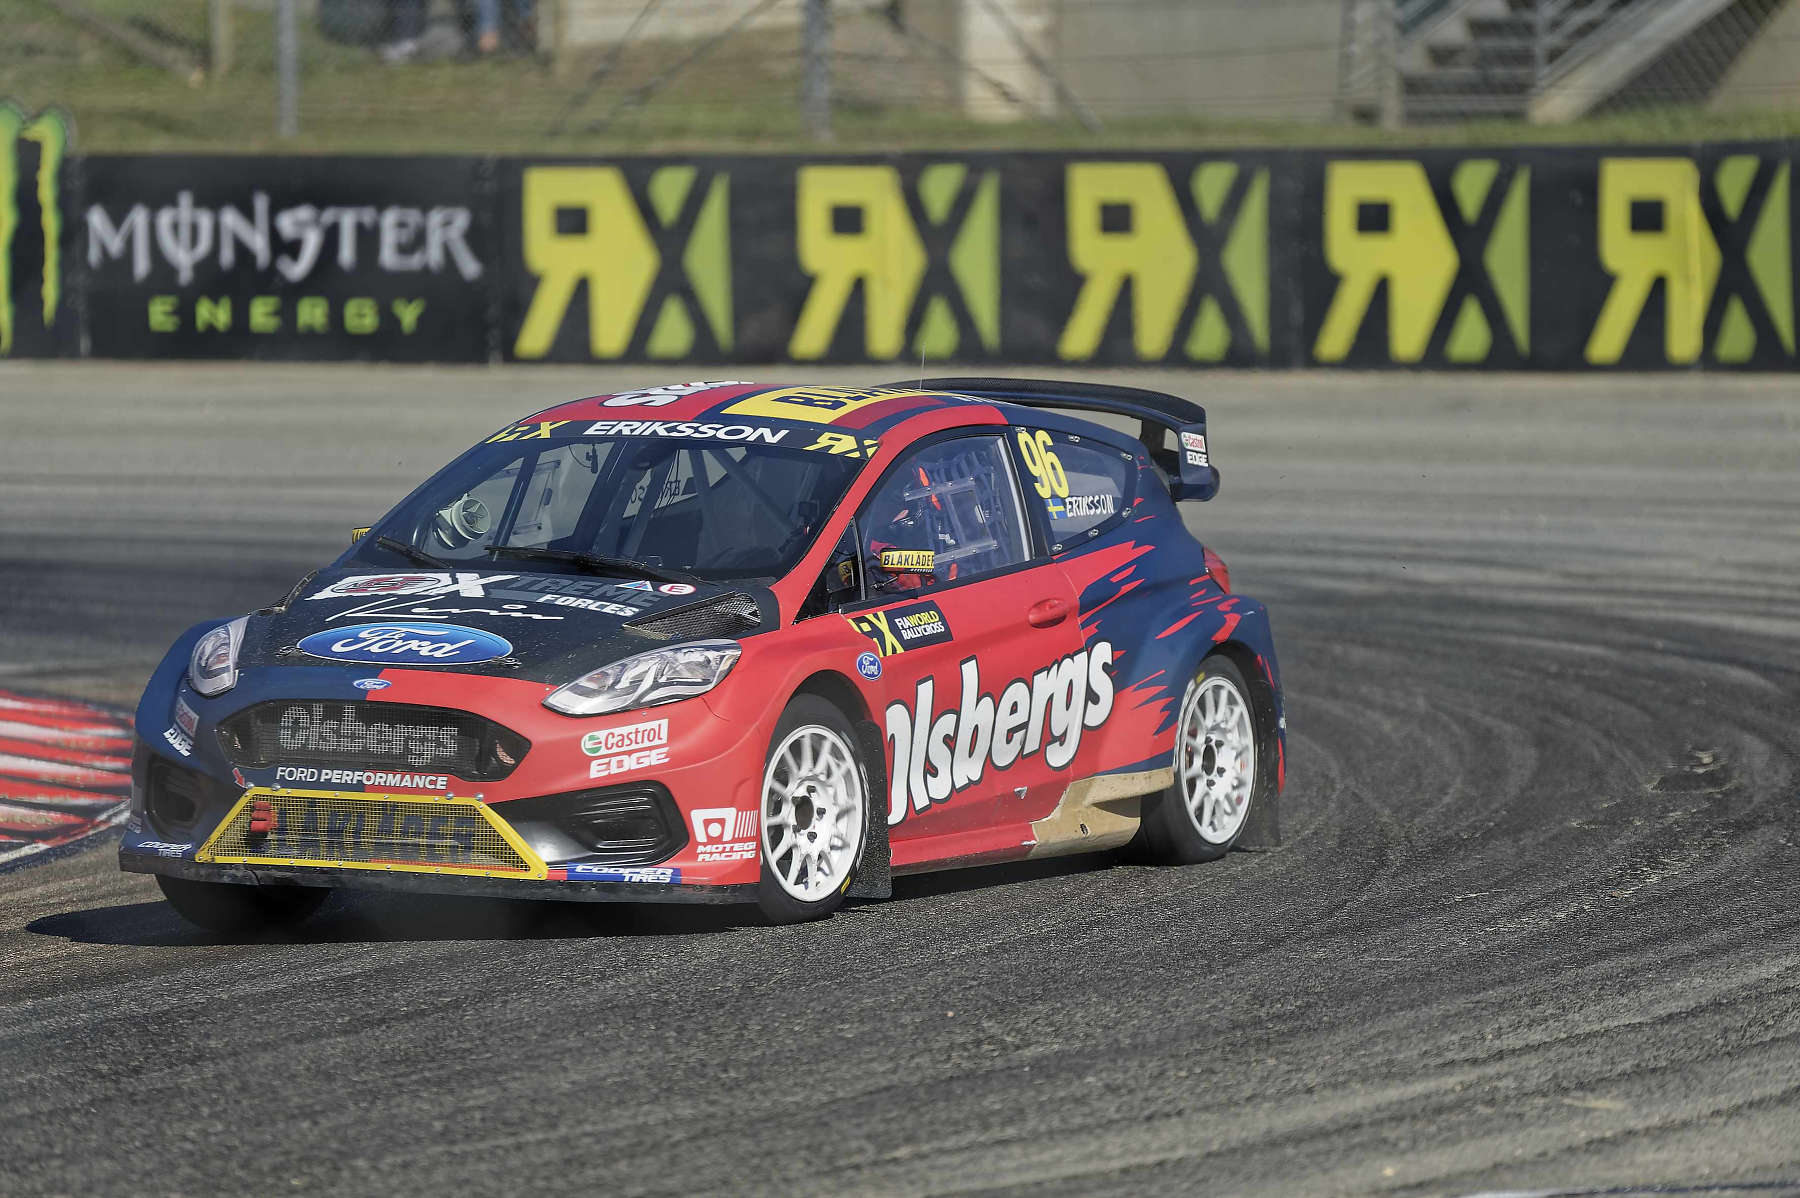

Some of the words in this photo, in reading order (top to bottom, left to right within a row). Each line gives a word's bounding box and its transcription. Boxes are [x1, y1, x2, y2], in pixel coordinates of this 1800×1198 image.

[87, 190, 484, 286] MONSTER
[148, 296, 425, 335] ENERGY
[582, 421, 789, 444] ERIKSSON
[1017, 429, 1069, 499] 96
[1065, 494, 1115, 518] ERIKSSON
[536, 594, 641, 617] FORCES
[331, 627, 476, 658] Ford
[901, 622, 945, 640] RALLYCROSS
[861, 655, 879, 675] Ford
[279, 703, 459, 767] Olsbergs
[604, 723, 663, 751] Castrol
[589, 747, 671, 779] EDGE
[276, 766, 318, 782] FORD
[320, 769, 448, 790] PERFORMANCE
[696, 842, 757, 854] MOTEGI
[696, 851, 756, 862] RACING
[575, 864, 674, 876] COOPER
[623, 873, 671, 884] TIRES
